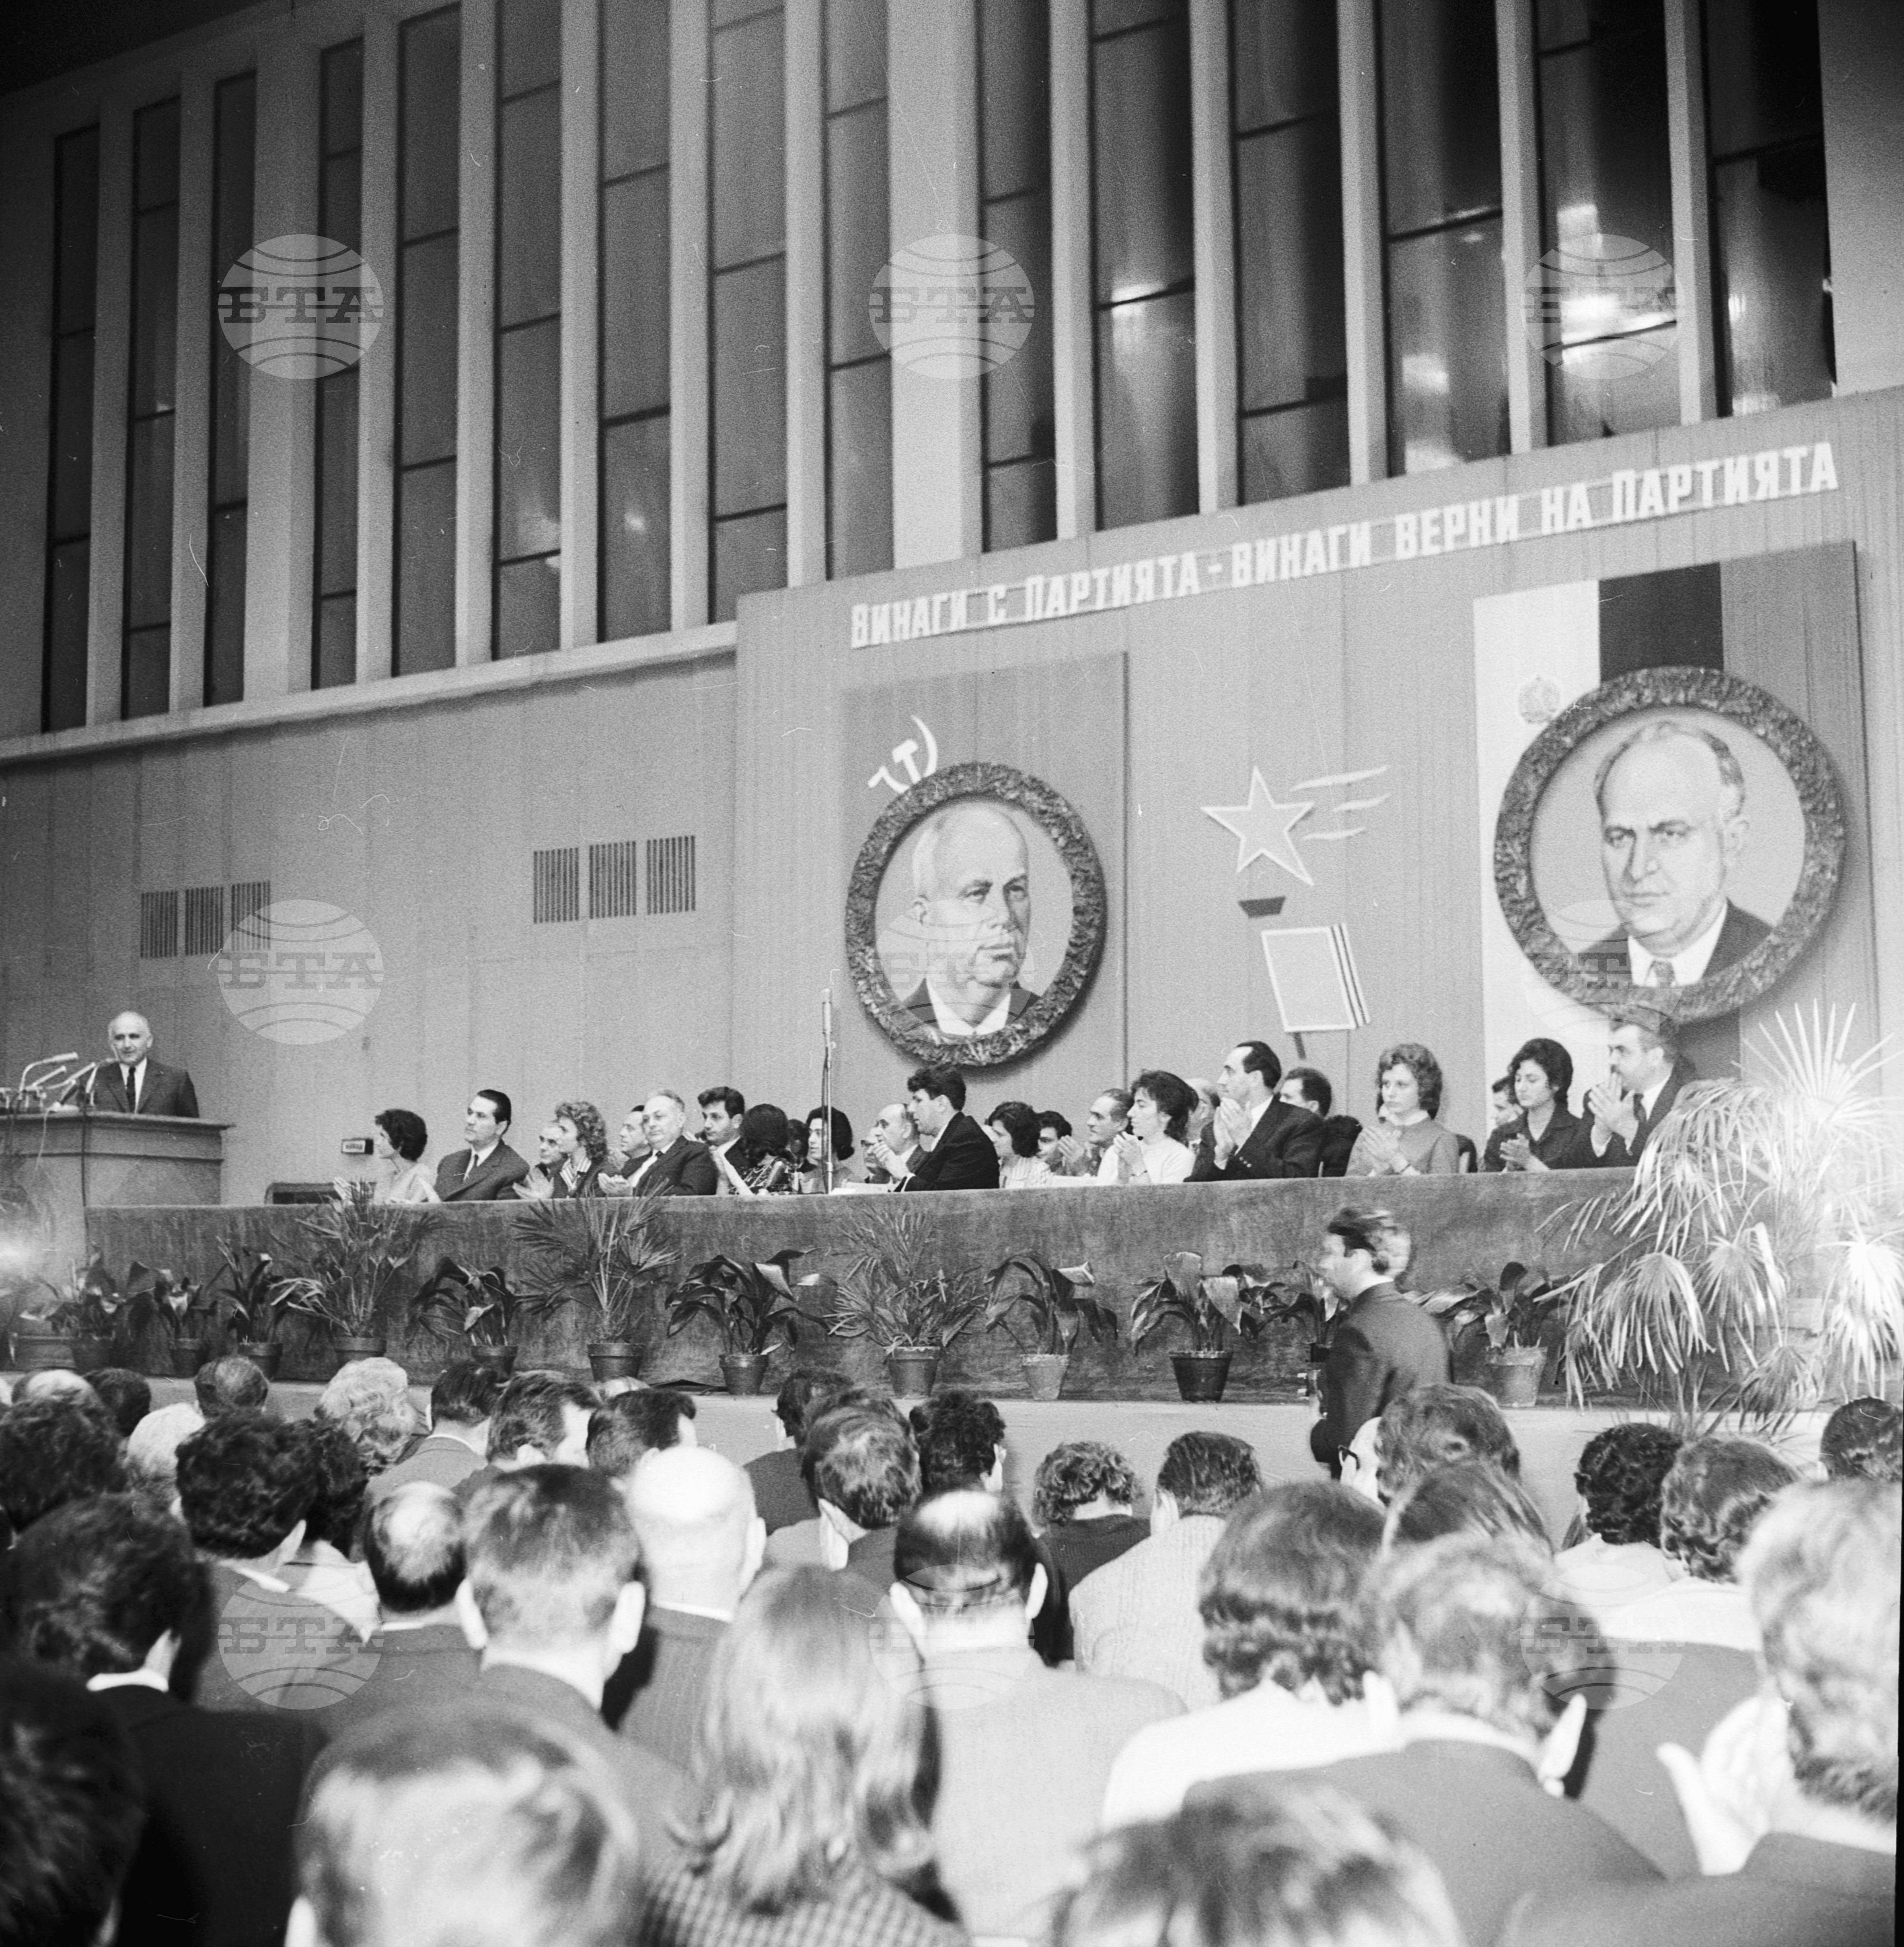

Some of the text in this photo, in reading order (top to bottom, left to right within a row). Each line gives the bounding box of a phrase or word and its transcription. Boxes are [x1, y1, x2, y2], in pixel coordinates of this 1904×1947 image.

[851, 588, 968, 649] ВИНАГИ
[988, 584, 1007, 623] С
[1026, 551, 1200, 622] ПАРТИЯТА
[1232, 520, 1370, 588] ВИНАГИ
[1395, 495, 1519, 560] ВЕРНИ
[1542, 483, 1593, 535] НА
[1613, 441, 1839, 522] ПАРТИЯТА
